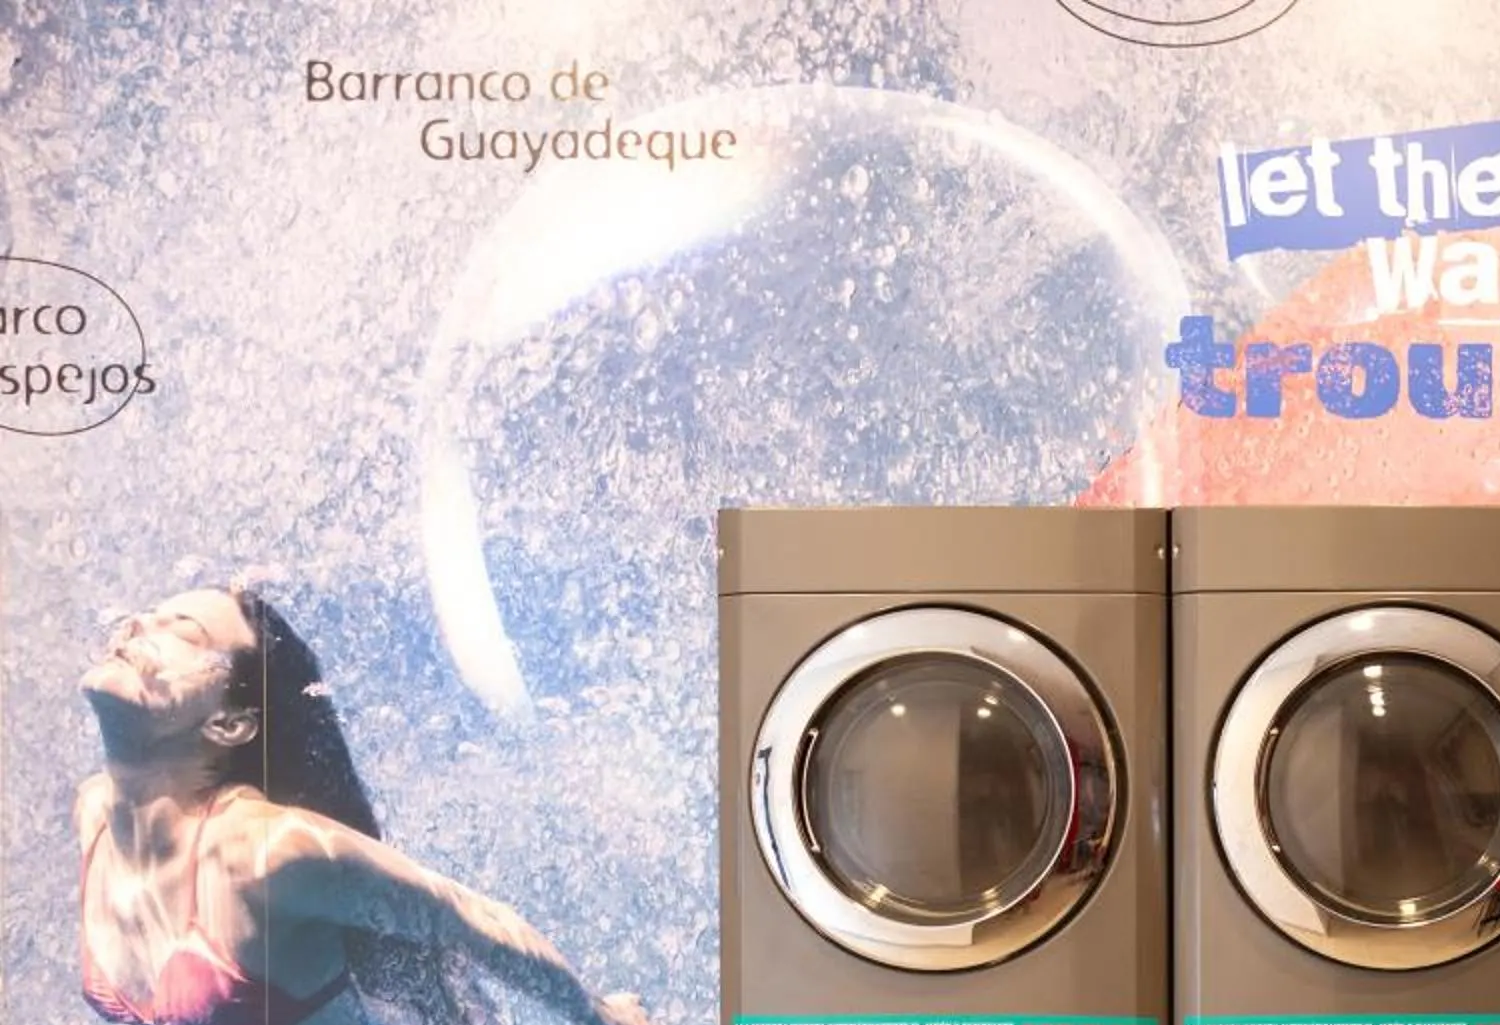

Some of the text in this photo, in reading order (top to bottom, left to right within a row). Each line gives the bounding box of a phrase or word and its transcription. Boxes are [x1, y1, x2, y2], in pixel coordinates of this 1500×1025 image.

[306, 59, 609, 101] Barranco de
[420, 117, 737, 174] Guayadeque
[1219, 137, 1344, 227] let
[0, 304, 86, 336] rco
